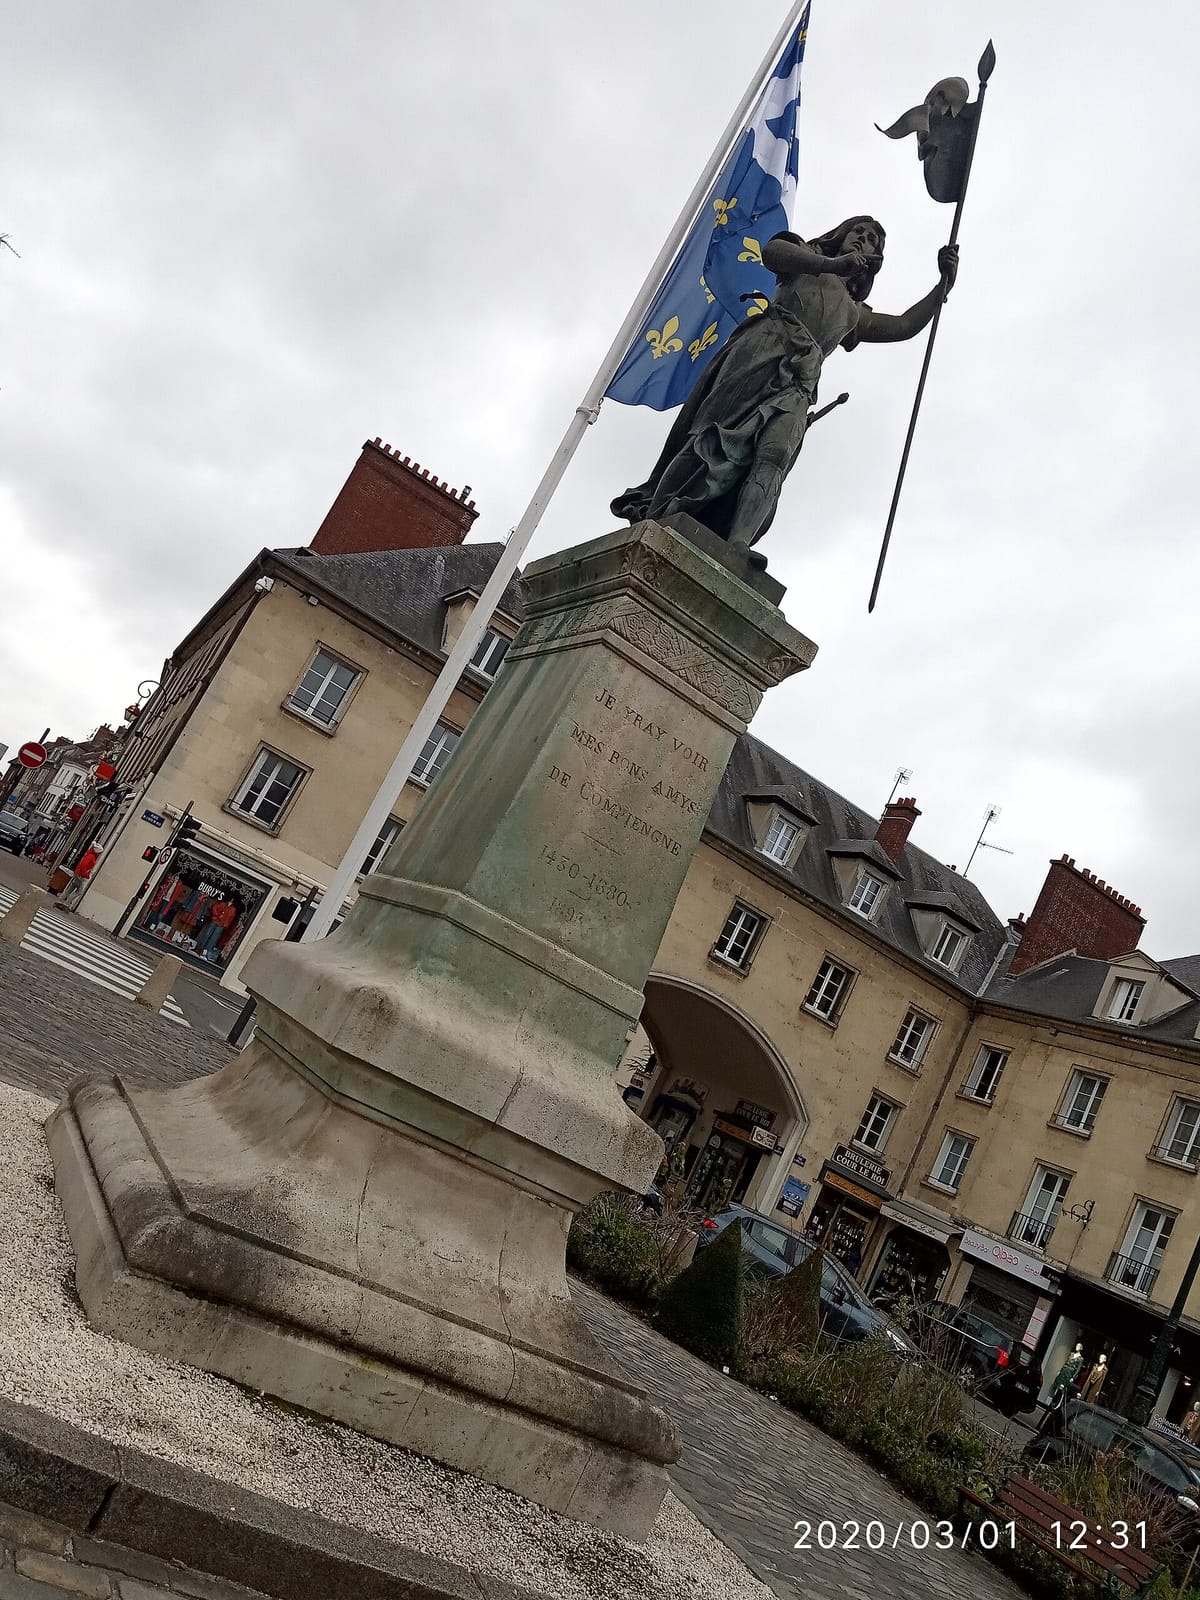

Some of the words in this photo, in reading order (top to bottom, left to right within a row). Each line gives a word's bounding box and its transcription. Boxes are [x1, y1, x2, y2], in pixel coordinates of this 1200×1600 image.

[595, 688, 617, 711] JE
[625, 705, 668, 741] YRAY
[672, 737, 709, 772] VOIR
[570, 725, 605, 754] MES
[607, 750, 649, 782] BONS
[548, 765, 571, 789] DE
[198, 881, 225, 901] BURLY'S
[836, 1154, 858, 1171] COUR
[858, 1166, 870, 1177] LE
[870, 1172, 886, 1185] ROI
[844, 1150, 883, 1175] BRULERIE
[1153, 1413, 1185, 1435] Collection
